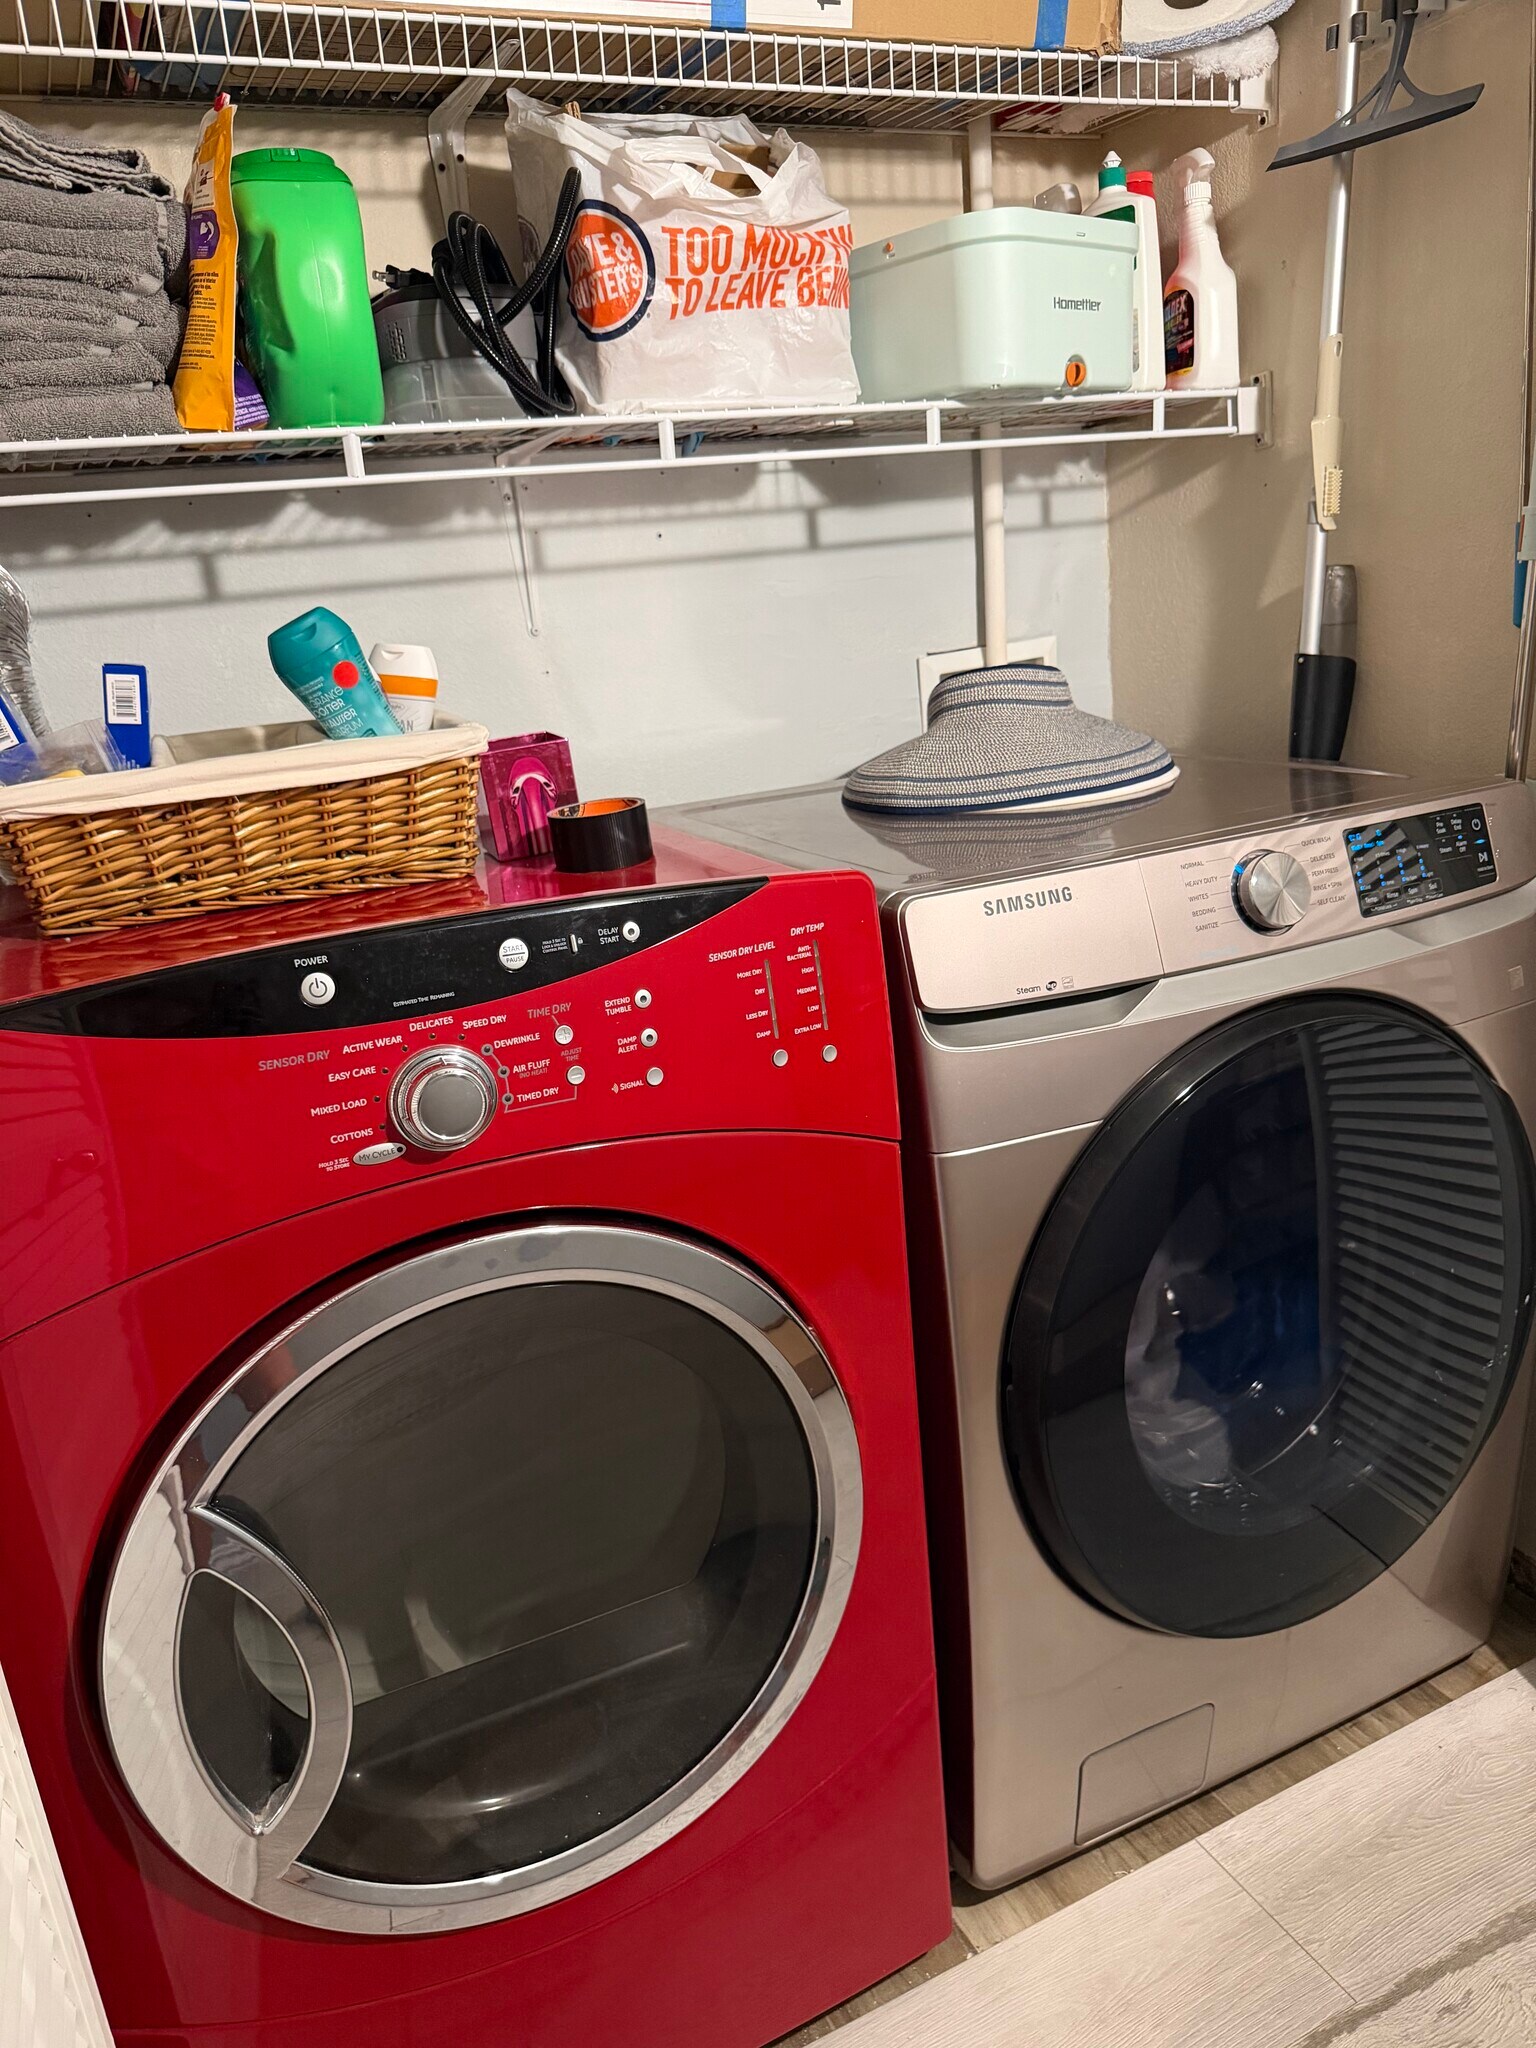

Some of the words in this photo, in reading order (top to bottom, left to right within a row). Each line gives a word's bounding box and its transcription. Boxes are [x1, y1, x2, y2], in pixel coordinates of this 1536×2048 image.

[611, 231, 635, 262] &
[661, 225, 734, 276] TOO
[740, 223, 826, 272] MUCH
[665, 277, 703, 320] TO
[705, 268, 790, 313] LEAVE
[1053, 296, 1101, 312] Homettler
[1300, 837, 1317, 847] QUICK
[1316, 835, 1331, 845] WASH
[1309, 852, 1336, 864] DELICATES
[1179, 860, 1205, 871] NORMAL
[1311, 869, 1324, 877] PERM
[1324, 866, 1340, 875] PRESS
[1184, 878, 1203, 888] HEAVY
[1203, 875, 1218, 885] DUTY
[1312, 882, 1328, 892] RINSE
[1330, 881, 1343, 890] SPIN
[982, 886, 1073, 917] SAMSUNG
[1188, 892, 1209, 903] WHITES
[1317, 897, 1329, 906] SELF
[1191, 907, 1217, 918] BEDDING
[598, 926, 619, 937] DELAY
[790, 926, 805, 937] DRY
[805, 921, 825, 933] TEMP
[1195, 921, 1220, 932] SANITIZE
[599, 935, 620, 945] START
[502, 944, 524, 954] START
[708, 950, 737, 963] SENSOR
[738, 945, 754, 957] DRY
[754, 940, 776, 953] LEVEL
[293, 955, 329, 968] POWER
[505, 955, 525, 964] PAUSE
[786, 951, 813, 962] BACTERIAL
[736, 970, 752, 980] MORE
[751, 968, 763, 976] DRY
[801, 966, 815, 975] HIGH
[754, 987, 766, 996] DRY
[796, 985, 817, 995] MEDIUM
[1016, 985, 1042, 995] Steam
[392, 997, 418, 1008] ESTIMATED
[417, 995, 429, 1004] TIME
[429, 991, 455, 1001] REMAINING
[604, 996, 631, 1008] EXTEND
[527, 1005, 551, 1020] TIME
[552, 1002, 572, 1014] DRY
[605, 1004, 632, 1017] TUMBLE
[746, 1011, 758, 1020] LESS
[757, 1009, 769, 1018] DRY
[807, 1004, 820, 1013] LOW
[409, 1015, 454, 1032] DELICATES
[462, 1017, 489, 1030] SPEED
[489, 1014, 507, 1025] DRY
[756, 1029, 772, 1039] DAMP
[794, 1025, 810, 1035] EXTRA
[809, 1022, 822, 1031] LOW
[342, 1040, 375, 1055] ACTIVE
[375, 1035, 403, 1048] WEAR
[493, 1033, 541, 1049] DEWRINKLE
[617, 1035, 637, 1046] DAMP
[560, 1046, 583, 1057] ADJUST
[617, 1043, 638, 1055] ALERT
[258, 1054, 305, 1072] SENSOR
[306, 1049, 331, 1063] DRY
[566, 1053, 580, 1062] TIME
[512, 1063, 527, 1074] AIR
[527, 1058, 551, 1070] FLUFF
[328, 1071, 351, 1083] EASY
[352, 1065, 377, 1078] CARE
[619, 1079, 644, 1091] SIGNAL
[516, 1090, 542, 1103] TIMED
[542, 1086, 560, 1098] DRY
[310, 1104, 341, 1117] MIXED
[341, 1098, 368, 1111] LOAD
[330, 1127, 374, 1144] COTTONS
[358, 1154, 371, 1162] MY
[371, 1147, 396, 1159] CYCLE
[318, 1161, 334, 1169] HOLD
[333, 1162, 350, 1171] STORE
